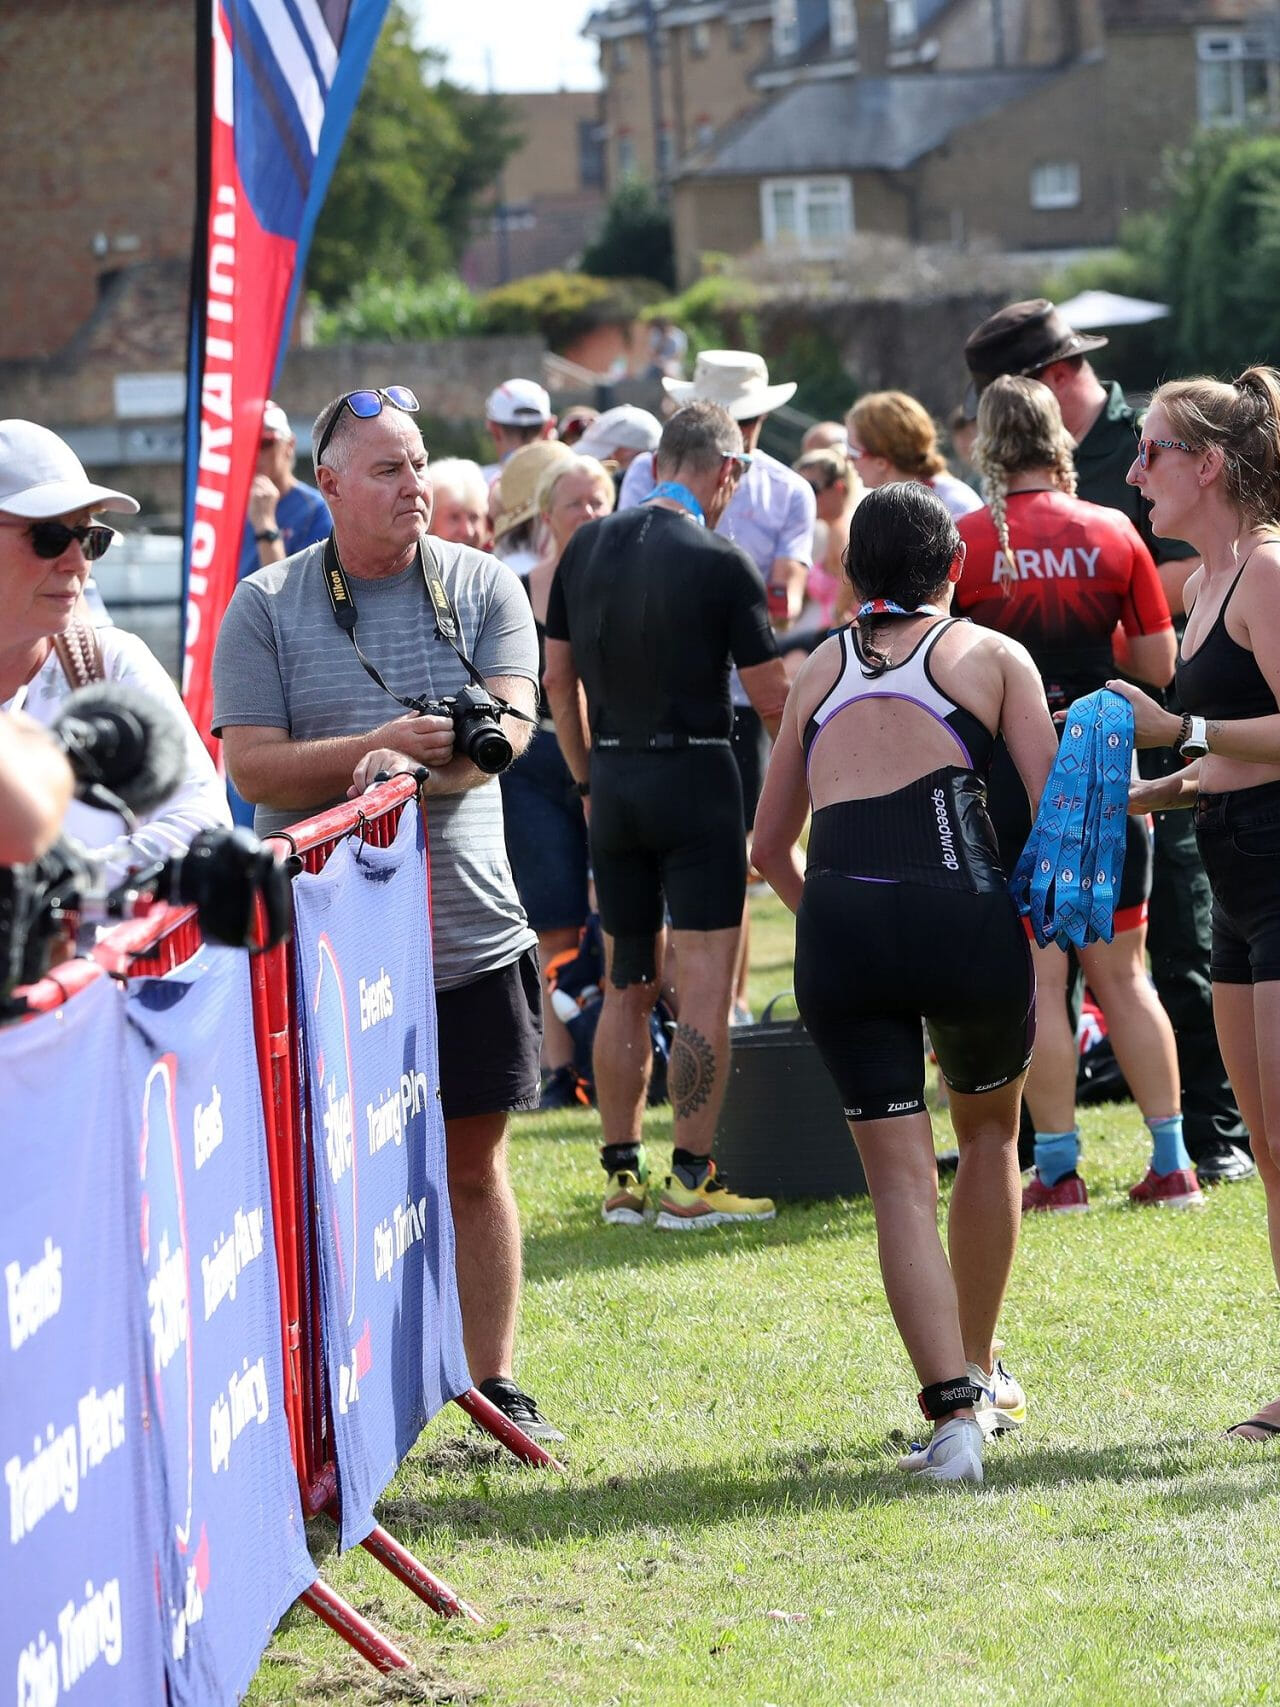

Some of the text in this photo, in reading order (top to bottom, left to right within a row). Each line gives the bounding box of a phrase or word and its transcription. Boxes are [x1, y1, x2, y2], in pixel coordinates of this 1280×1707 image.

[332, 569, 346, 601] Nikon
[992, 547, 1101, 583] ARMY
[930, 788, 960, 871] speedwrap
[58, 1577, 122, 1692] Timing
